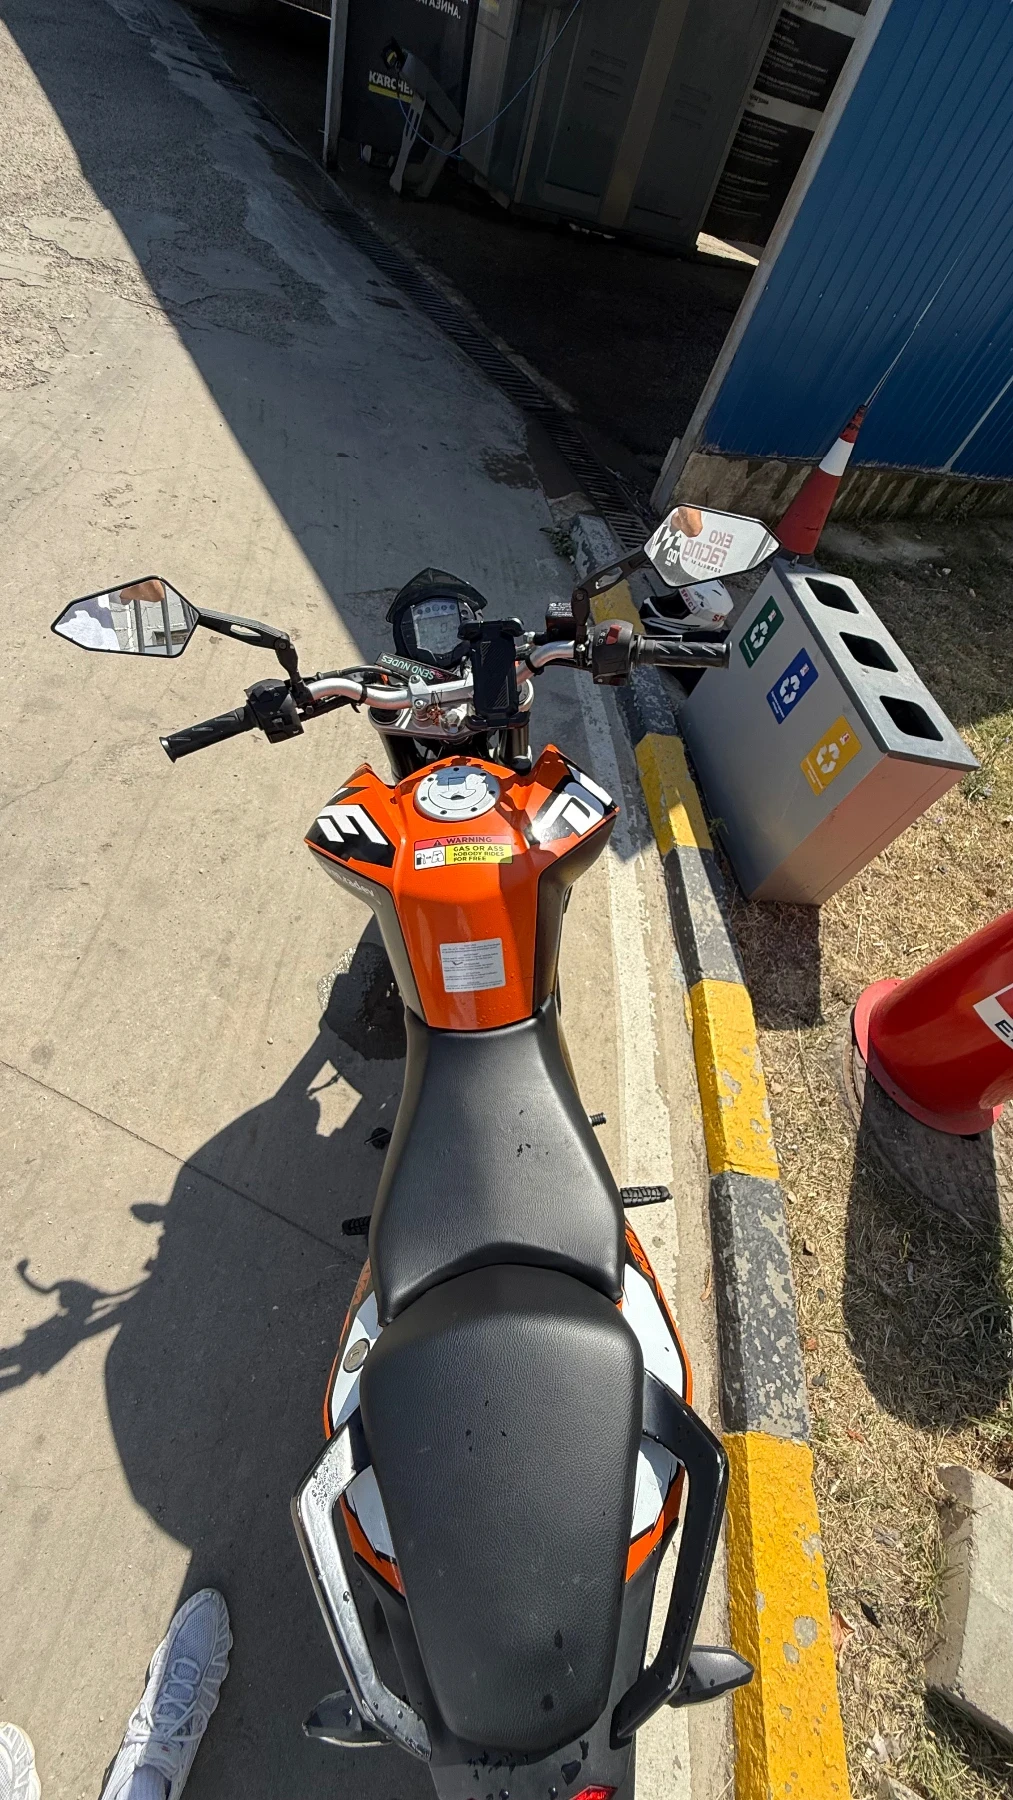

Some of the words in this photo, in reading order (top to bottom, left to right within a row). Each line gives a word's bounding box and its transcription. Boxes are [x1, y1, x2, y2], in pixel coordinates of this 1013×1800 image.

[416, 0, 461, 19] АЗИНА.
[368, 70, 414, 95] KÄRCHE
[381, 655, 411, 671] NUDES
[411, 665, 435, 680] SEND
[446, 836, 492, 844] WARNING
[994, 1019, 1013, 1042] E
